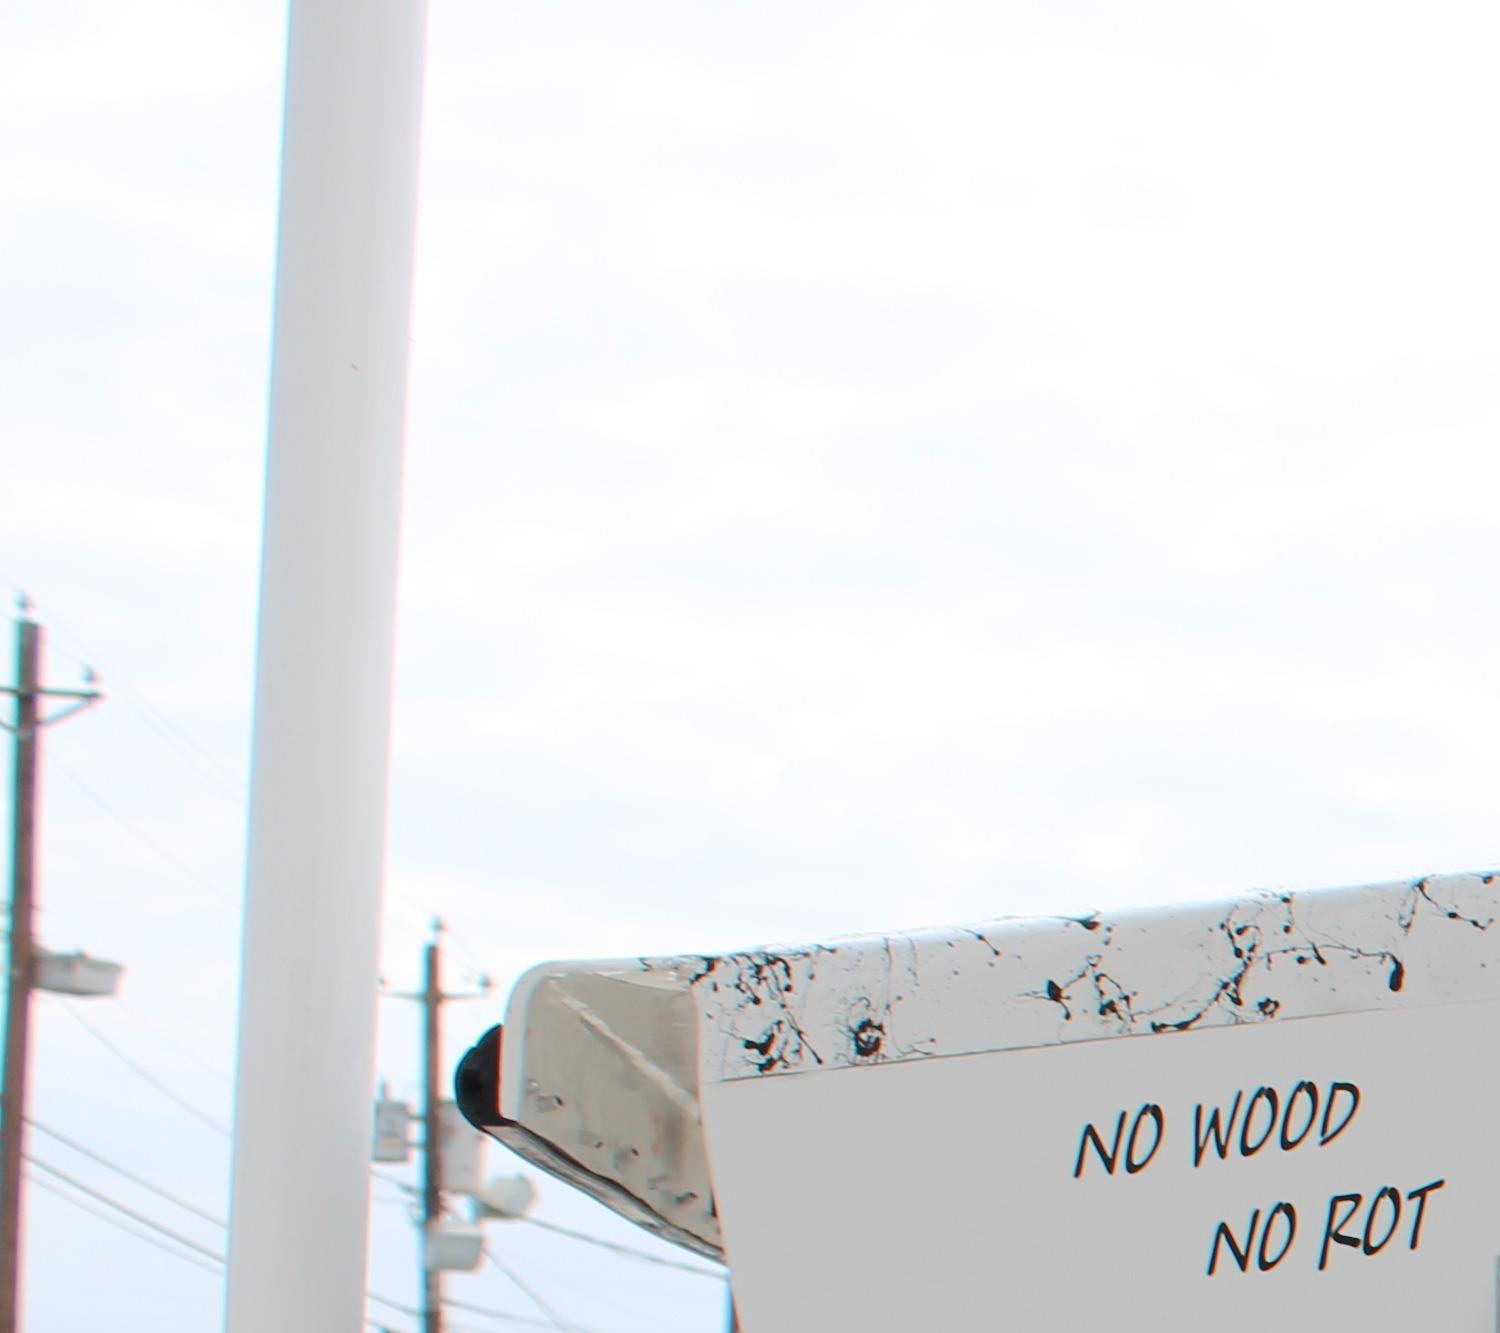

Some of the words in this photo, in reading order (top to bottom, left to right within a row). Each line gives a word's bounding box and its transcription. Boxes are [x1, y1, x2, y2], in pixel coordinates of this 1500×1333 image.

[1074, 1103, 1165, 1179] NO
[1193, 1080, 1361, 1168] WOOD
[1207, 1201, 1298, 1276] NO
[1318, 1178, 1445, 1271] ROT
